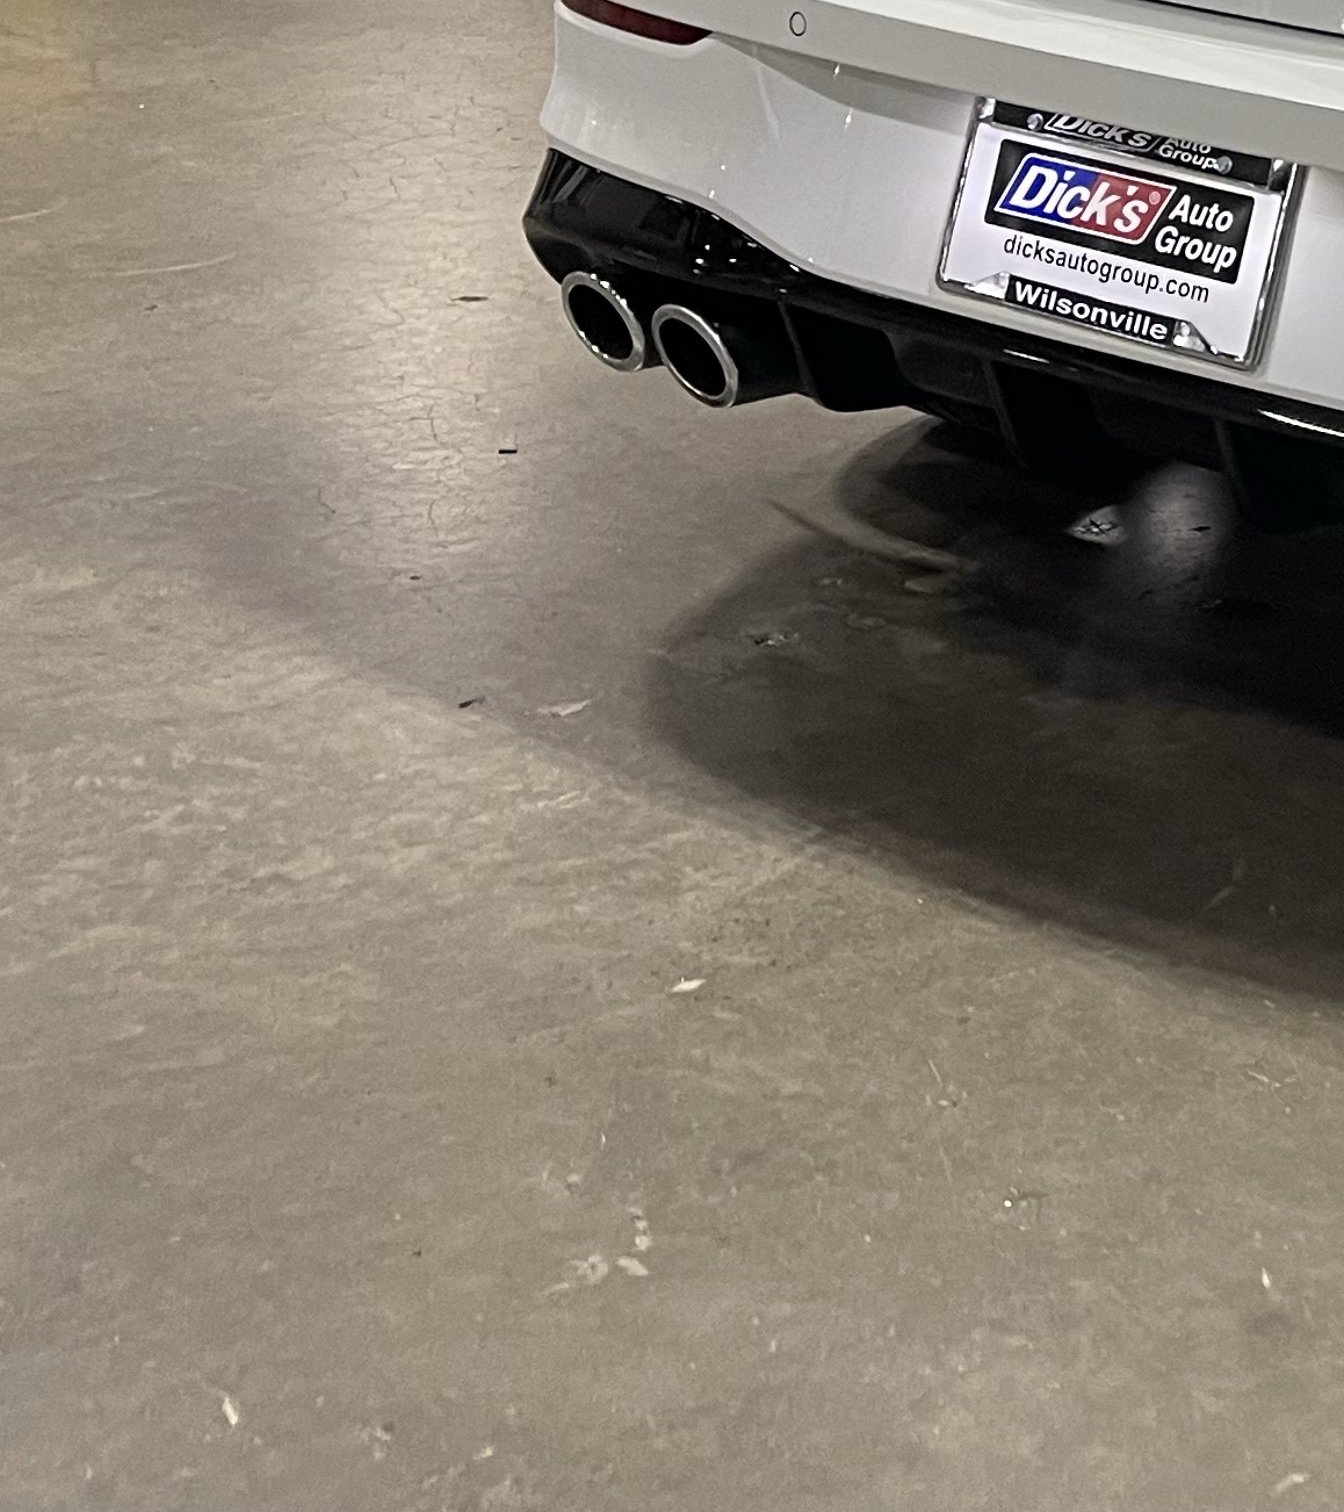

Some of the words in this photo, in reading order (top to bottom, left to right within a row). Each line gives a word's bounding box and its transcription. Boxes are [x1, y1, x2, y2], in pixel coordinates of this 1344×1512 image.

[1158, 144, 1220, 170] Group
[1009, 164, 1149, 233] Dick's
[1168, 194, 1234, 232] Auto
[1003, 234, 1209, 304] dicksautogroup.com
[1154, 225, 1237, 274] Group
[1015, 280, 1169, 340] Wilsonville
